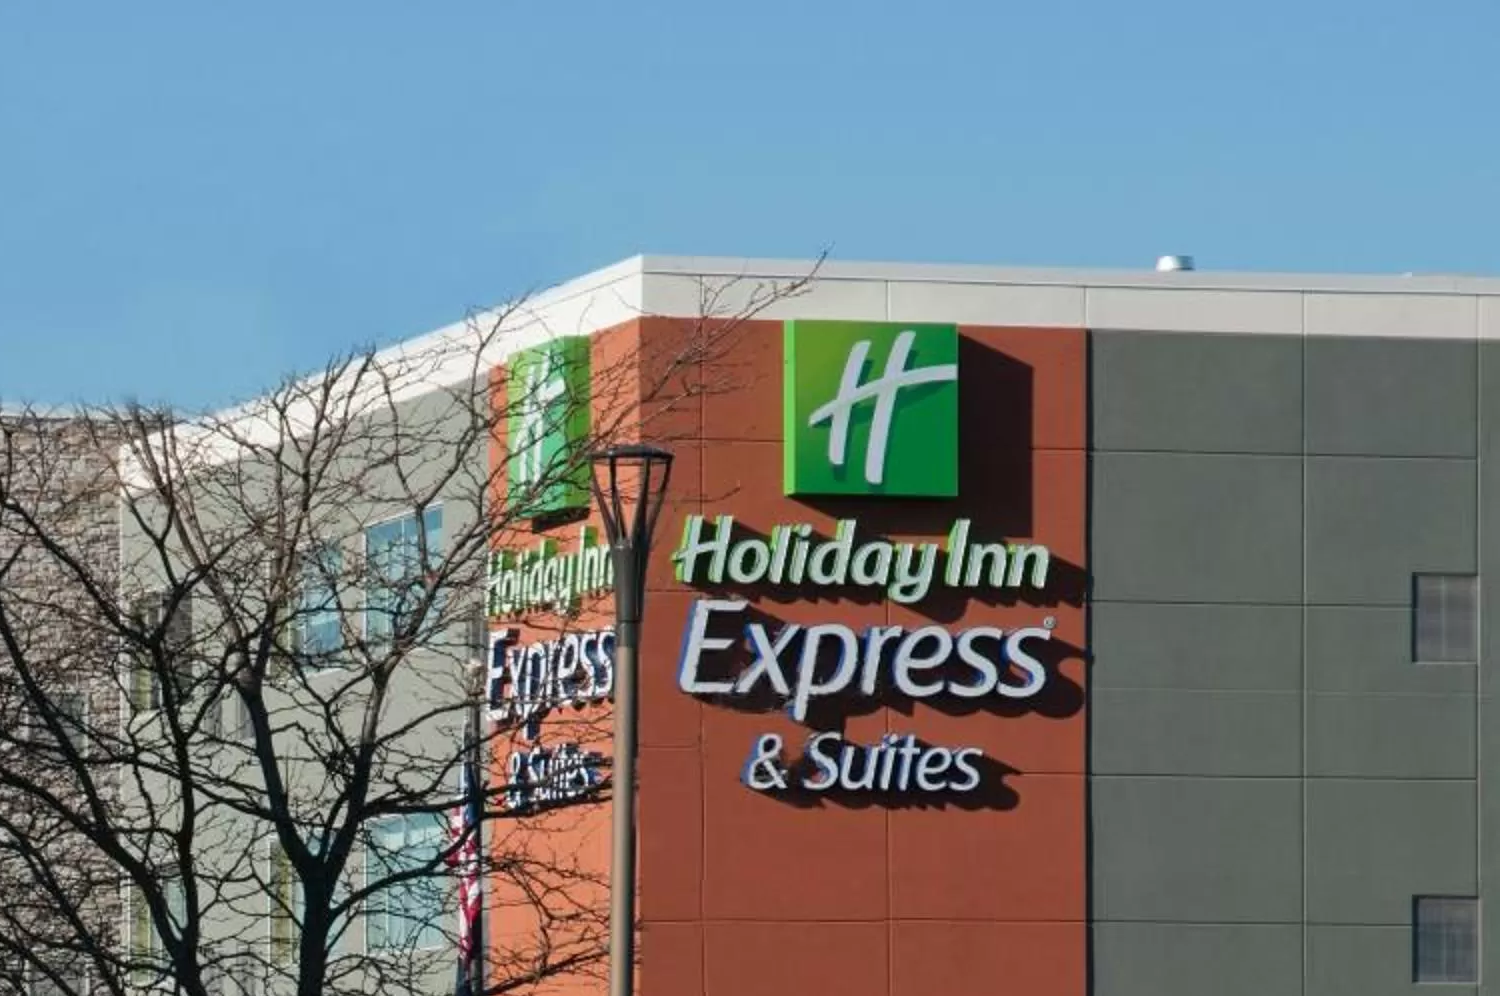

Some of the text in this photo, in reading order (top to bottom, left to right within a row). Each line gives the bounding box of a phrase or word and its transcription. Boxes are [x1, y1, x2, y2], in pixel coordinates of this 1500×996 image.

[809, 331, 957, 484] H
[485, 525, 614, 614] Holiday Inn
[674, 515, 1049, 602] Holiday Inn
[485, 627, 615, 740] Express
[743, 732, 983, 791] & Suites
